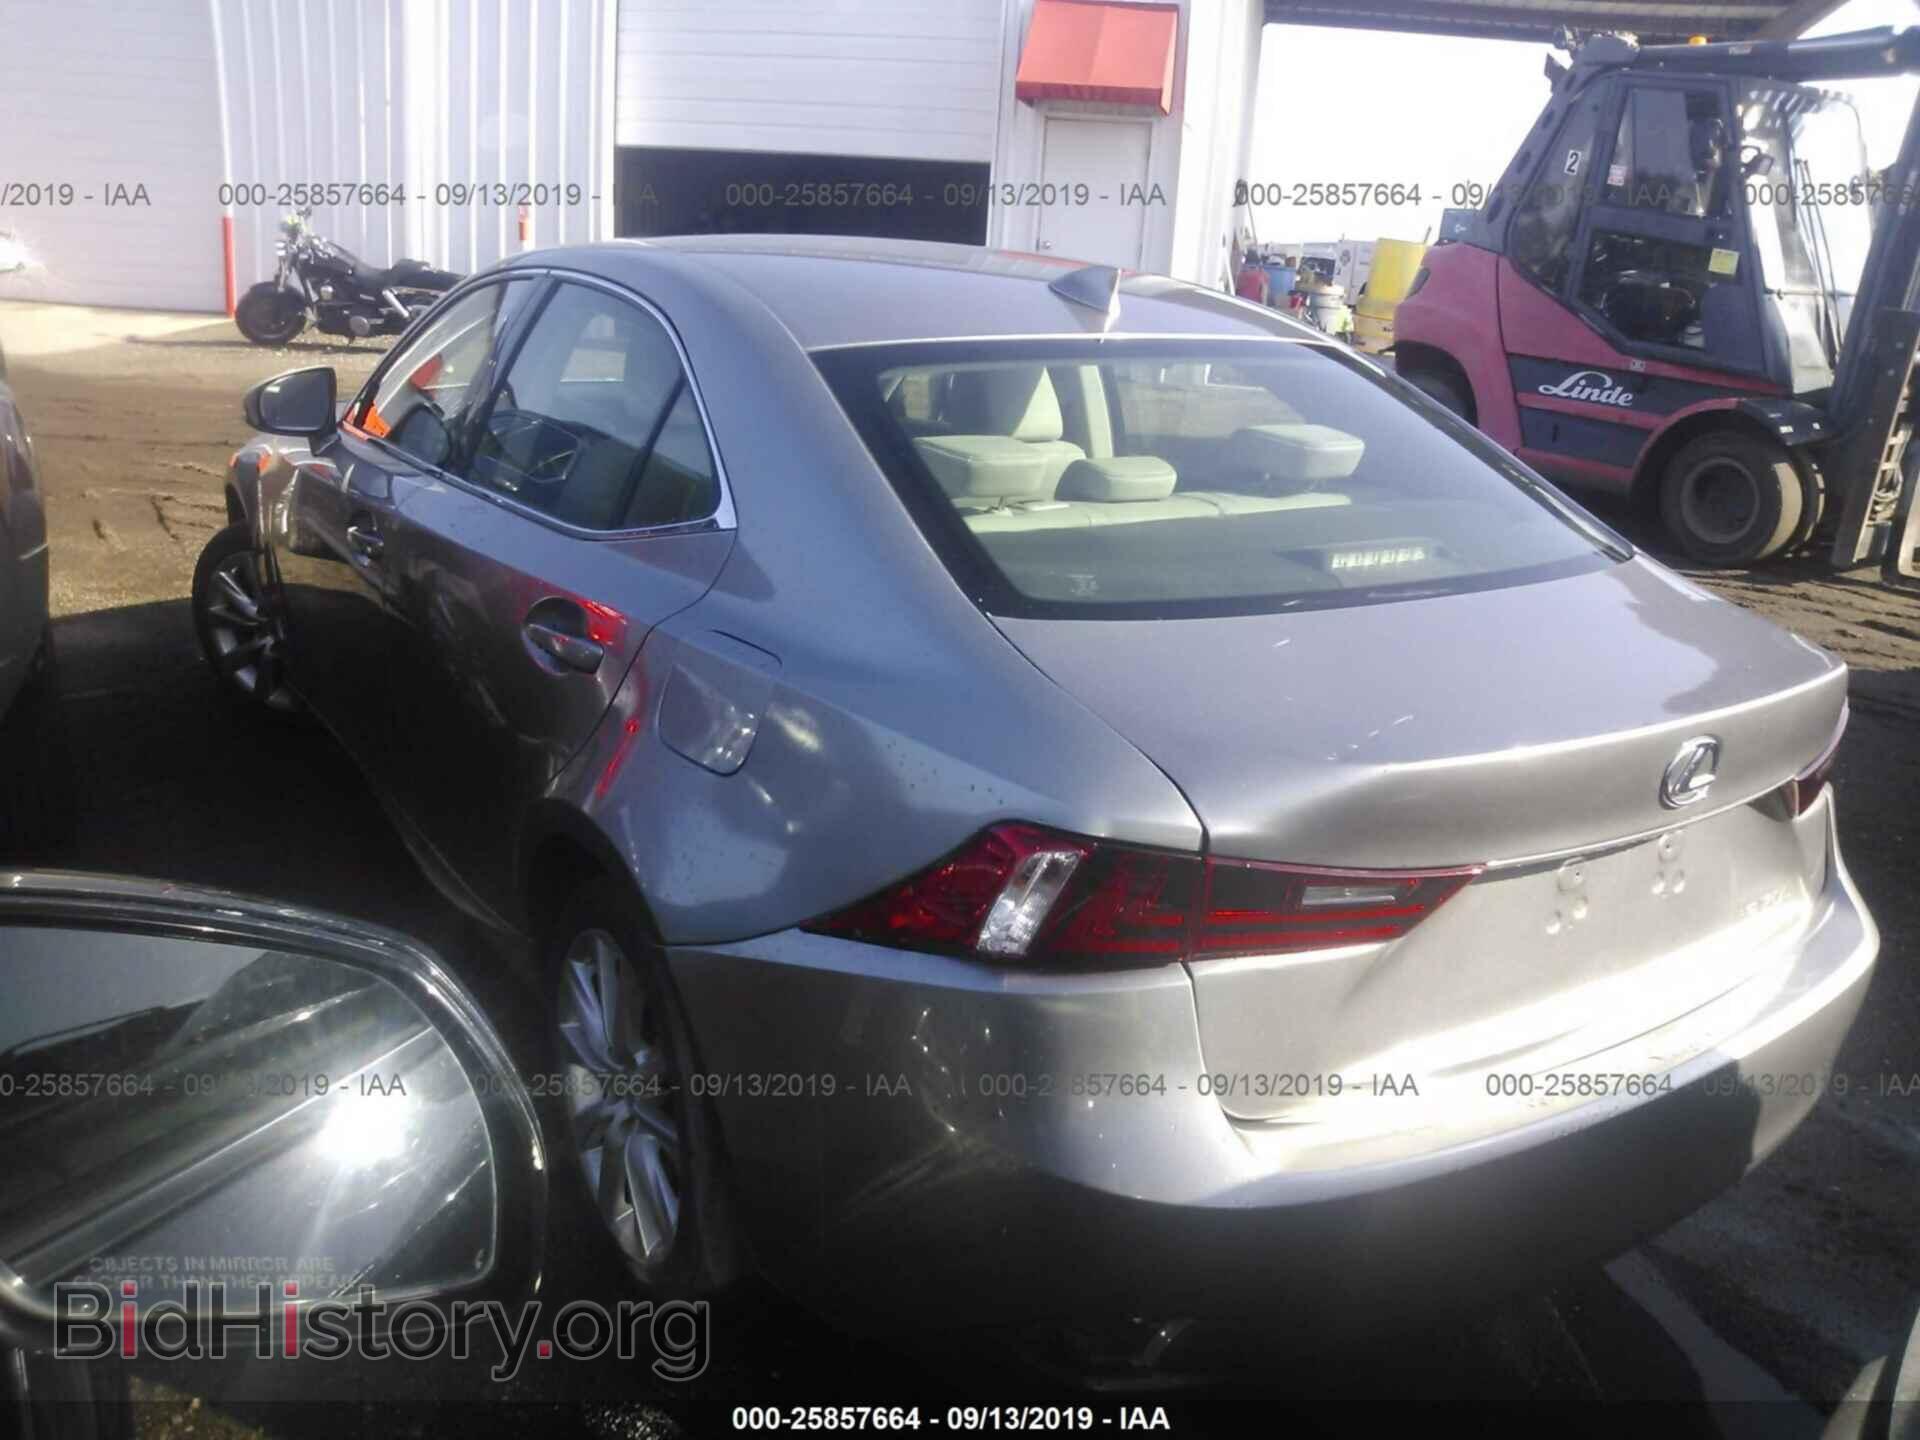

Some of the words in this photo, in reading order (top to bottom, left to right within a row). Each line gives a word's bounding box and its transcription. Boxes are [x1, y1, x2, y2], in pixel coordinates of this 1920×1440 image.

[1565, 151, 1580, 173] 2
[1538, 371, 1633, 406] Linde
[90, 1255, 177, 1272] OBJECTS
[184, 1255, 207, 1272] IN
[209, 1255, 289, 1272] MIRROR
[296, 1255, 337, 1272] ARE
